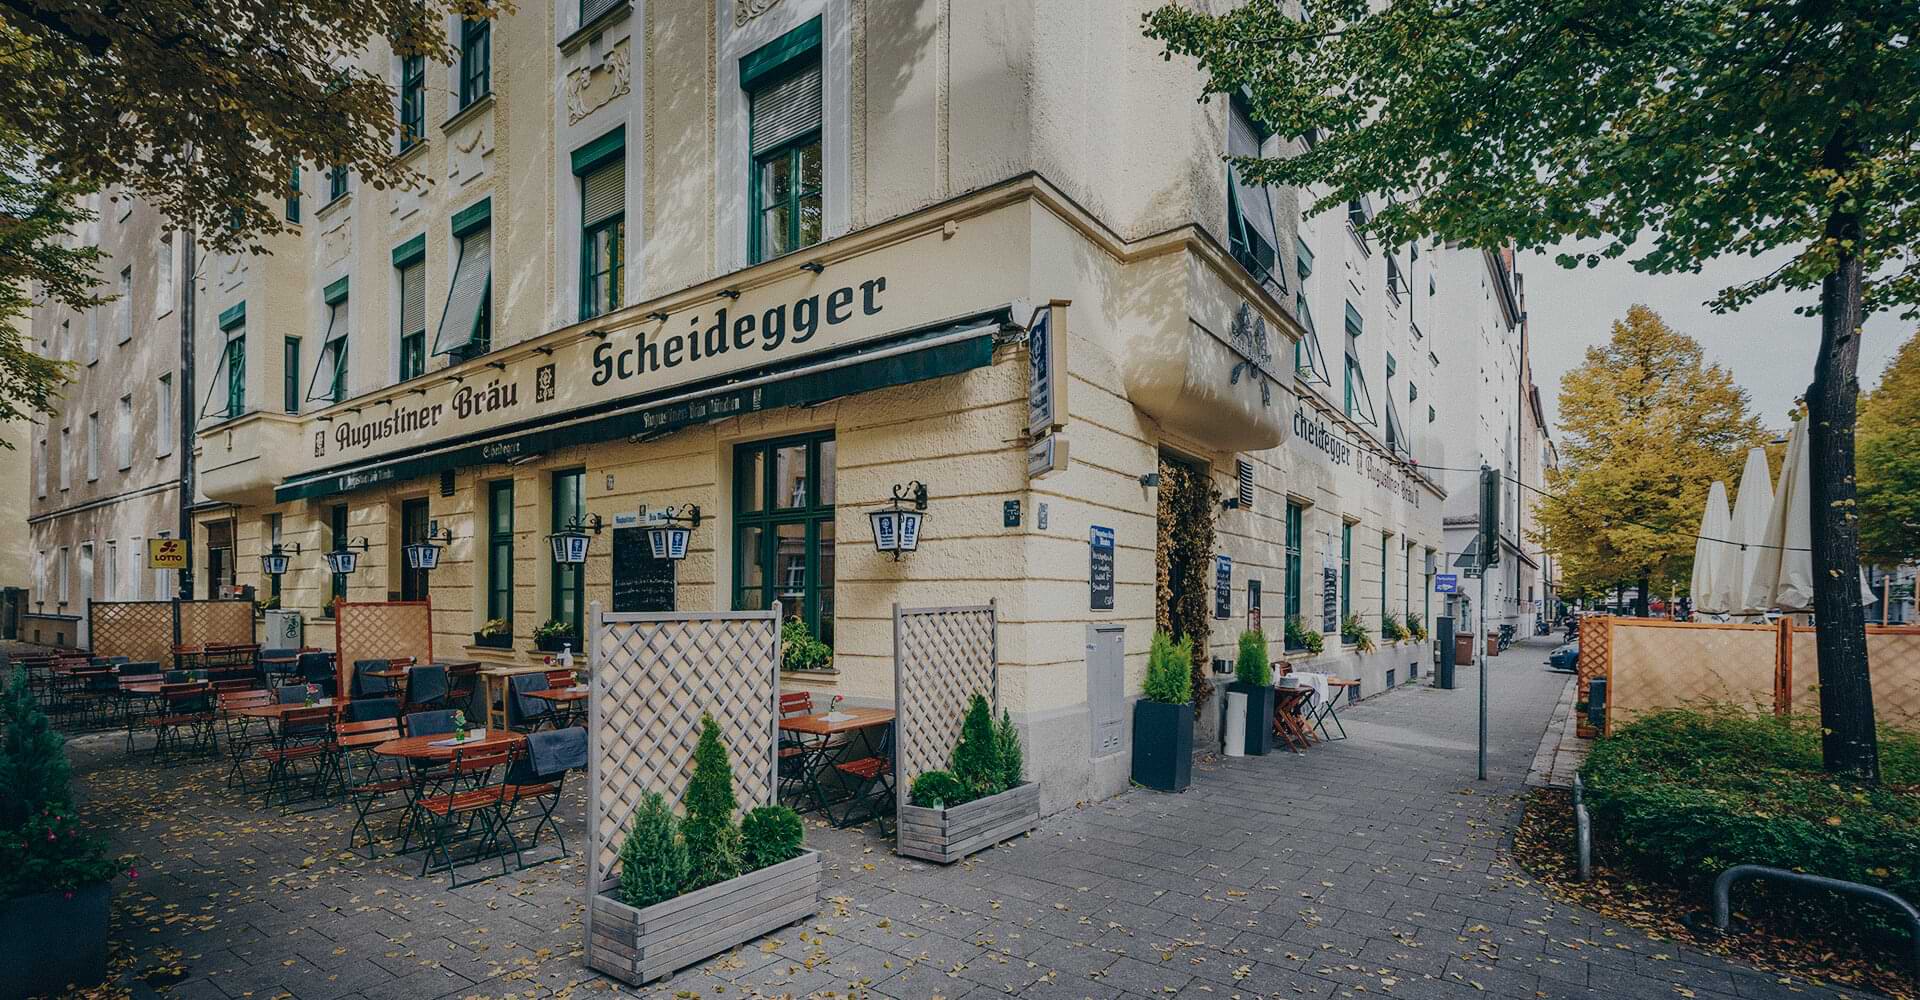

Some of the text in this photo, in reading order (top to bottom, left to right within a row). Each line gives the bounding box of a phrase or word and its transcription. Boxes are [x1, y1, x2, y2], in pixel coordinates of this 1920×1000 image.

[591, 276, 887, 386] Scheidegger
[335, 403, 443, 452] Augustiner
[451, 379, 518, 420] Bräu
[1293, 406, 1351, 466] cheidegger
